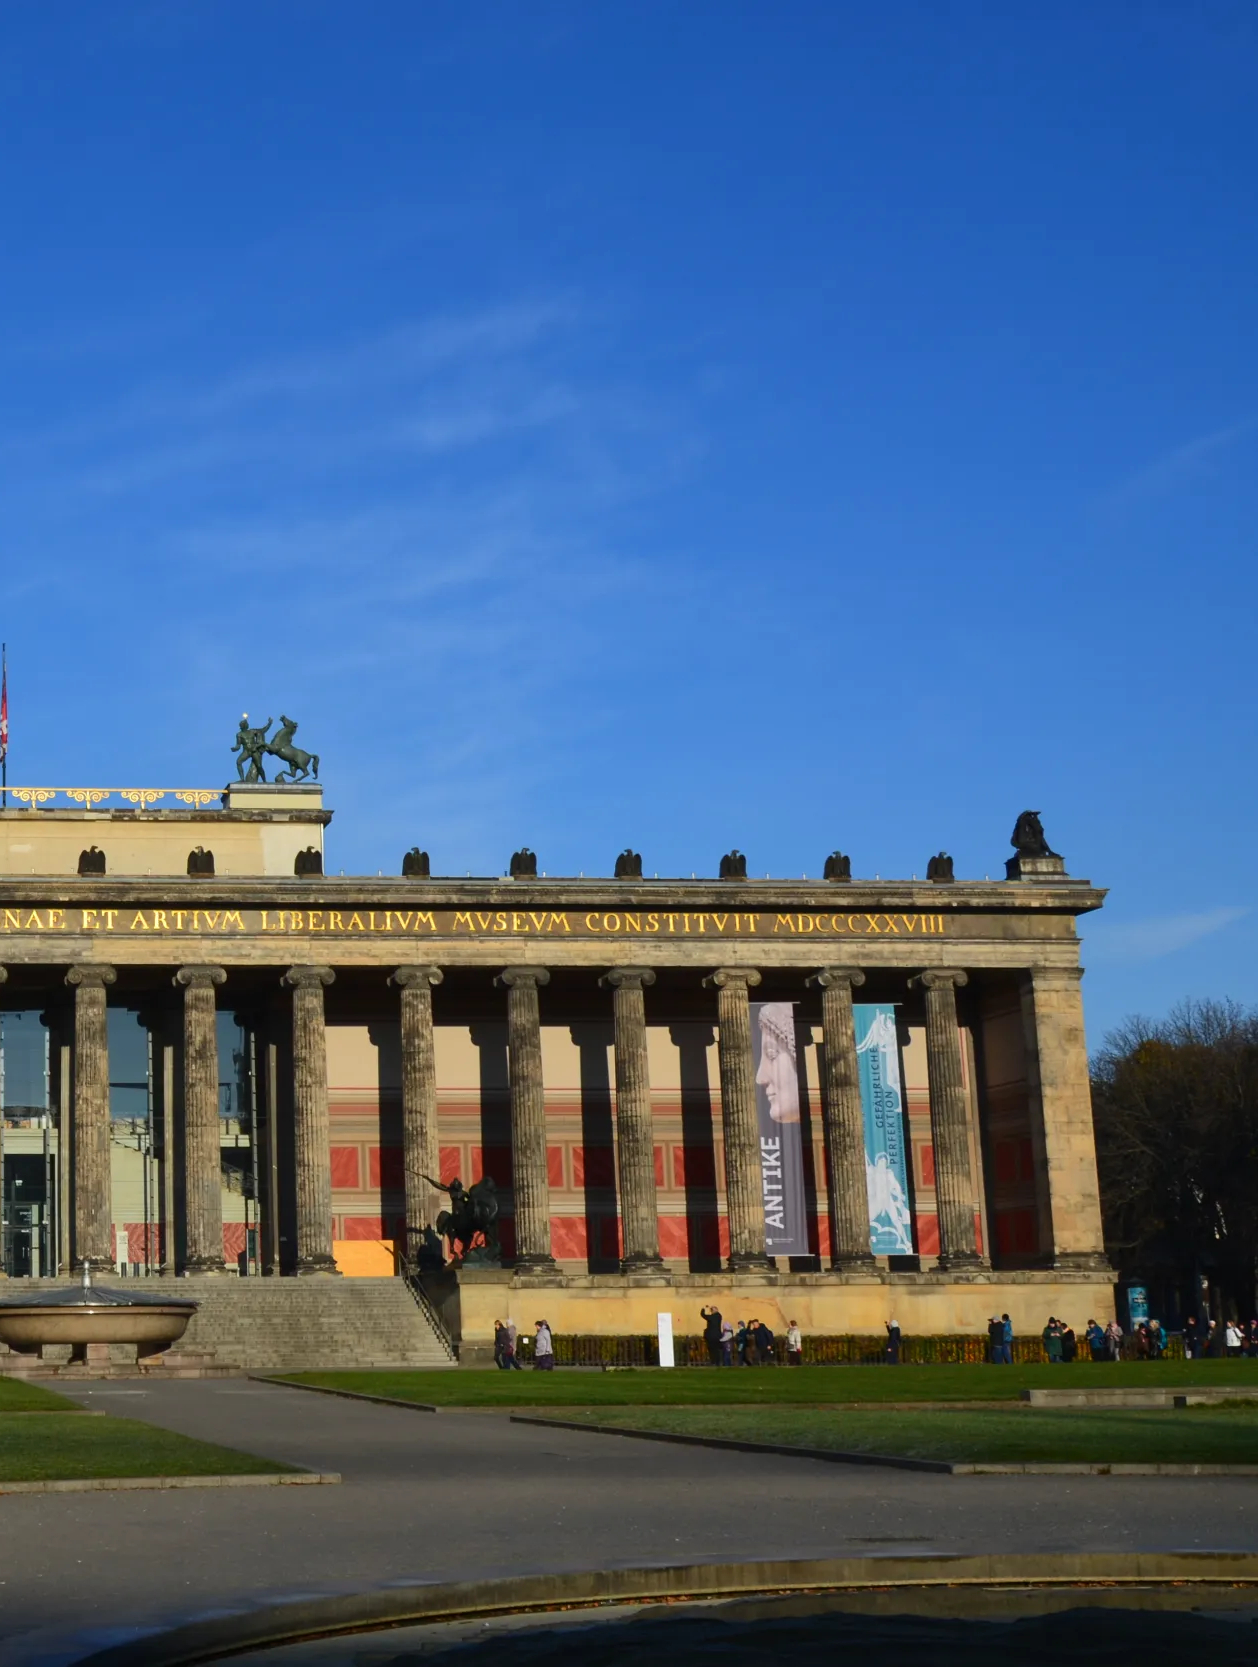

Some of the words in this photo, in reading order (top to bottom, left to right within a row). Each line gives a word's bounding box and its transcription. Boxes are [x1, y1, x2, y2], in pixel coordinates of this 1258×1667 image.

[81, 909, 119, 931] ET
[130, 910, 246, 932] ARTIVM
[260, 911, 438, 932] LIBERALIVM
[451, 912, 572, 933] MVSEVM
[584, 912, 761, 934] CONSTITVIT
[772, 913, 946, 935] MDCCCXXVIII
[869, 1047, 884, 1129] GEFÄHRLICHE
[885, 1091, 899, 1165] PERFEKTION
[760, 1136, 785, 1229] ANTIKE
